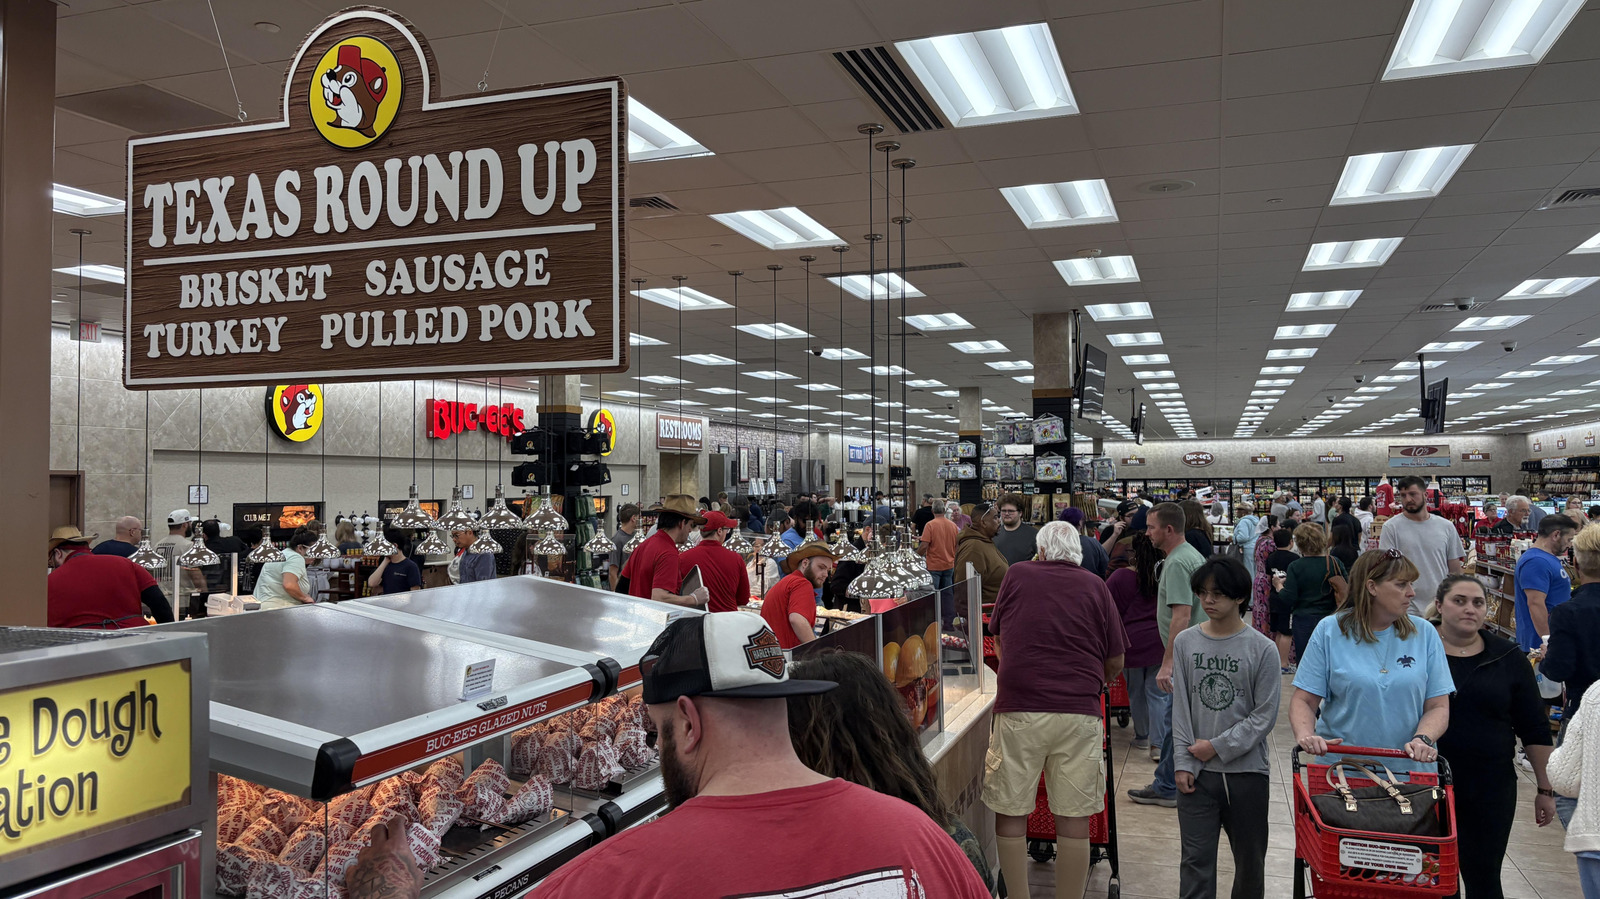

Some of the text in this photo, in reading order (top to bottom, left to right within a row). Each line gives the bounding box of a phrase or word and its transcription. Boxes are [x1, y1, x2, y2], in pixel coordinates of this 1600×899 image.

[144, 138, 598, 248] TEXAS ROUND UP
[178, 247, 551, 309] BRISKET SAUSAGE
[80, 323, 98, 340] EXIT
[143, 298, 595, 358] TURKEY PULLED PORK
[243, 513, 257, 522] CLUB
[1192, 652, 1240, 673] Levi's
[33, 679, 163, 757] Dough
[479, 711, 521, 734] GLAZED
[521, 700, 548, 720] NUTS
[410, 826, 434, 847] PECANS
[494, 873, 530, 899] PECANS
